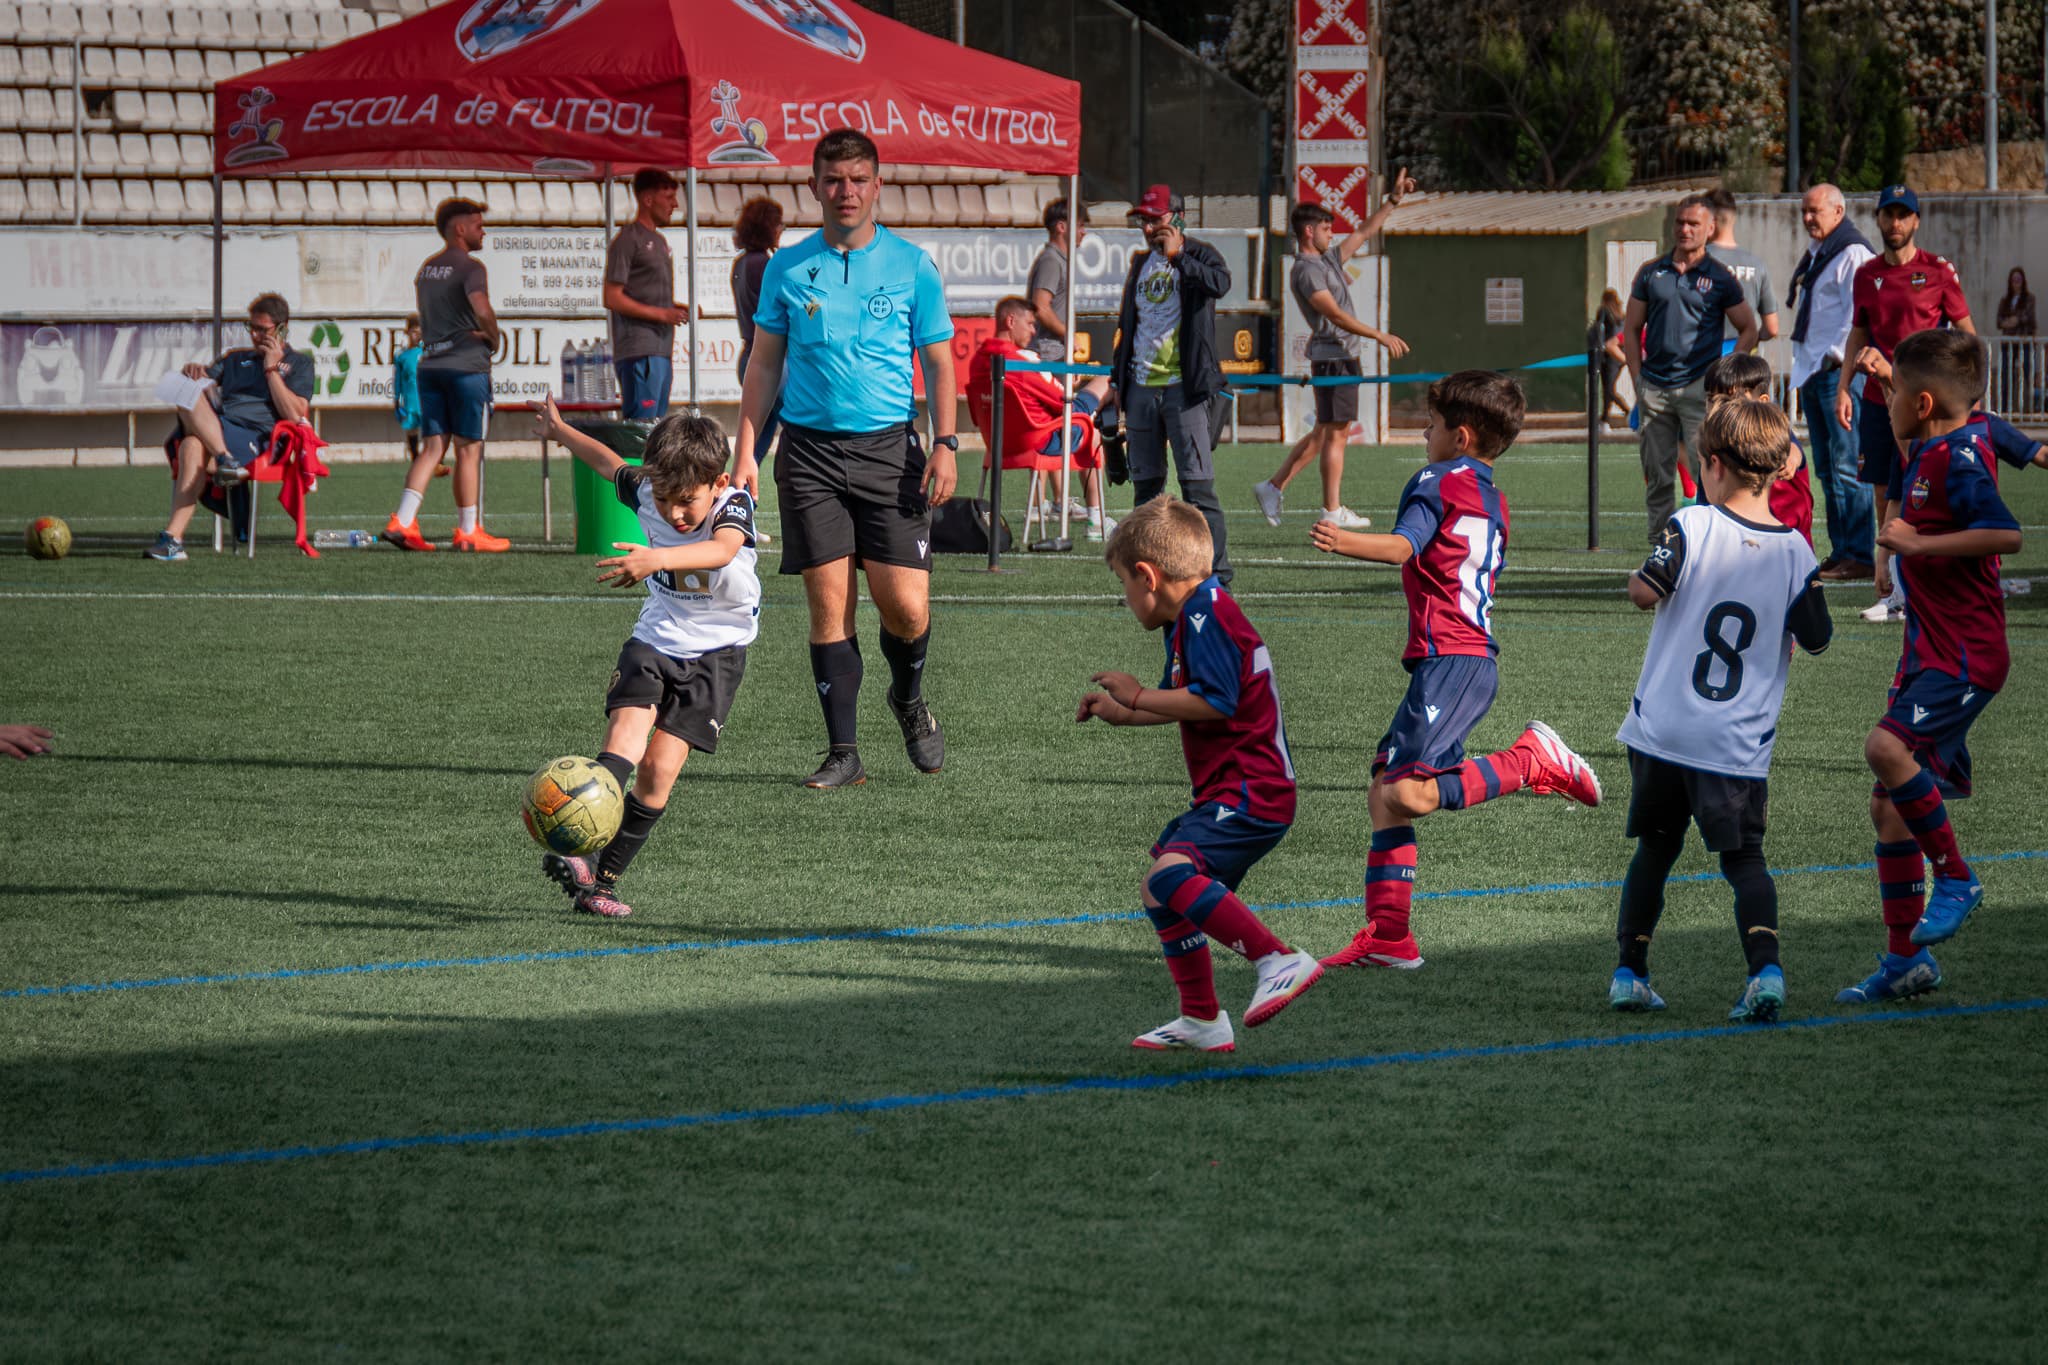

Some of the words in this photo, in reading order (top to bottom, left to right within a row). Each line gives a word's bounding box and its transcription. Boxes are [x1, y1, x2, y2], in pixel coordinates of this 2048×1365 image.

[303, 94, 439, 132] ESCOLA
[455, 94, 498, 126] de
[506, 97, 662, 137] FUTBOL
[1315, 71, 1366, 123] MOLINO
[1316, 86, 1366, 138] MOLINO
[781, 99, 909, 140] ESCOLA
[918, 103, 950, 137] de
[951, 105, 1068, 147] FUTBOL
[1299, 143, 1368, 152] CERAMICAS
[522, 255, 537, 269] DE
[540, 255, 602, 269] MANANTIAL
[576, 237, 591, 250] DE
[1692, 601, 1757, 702] 8
